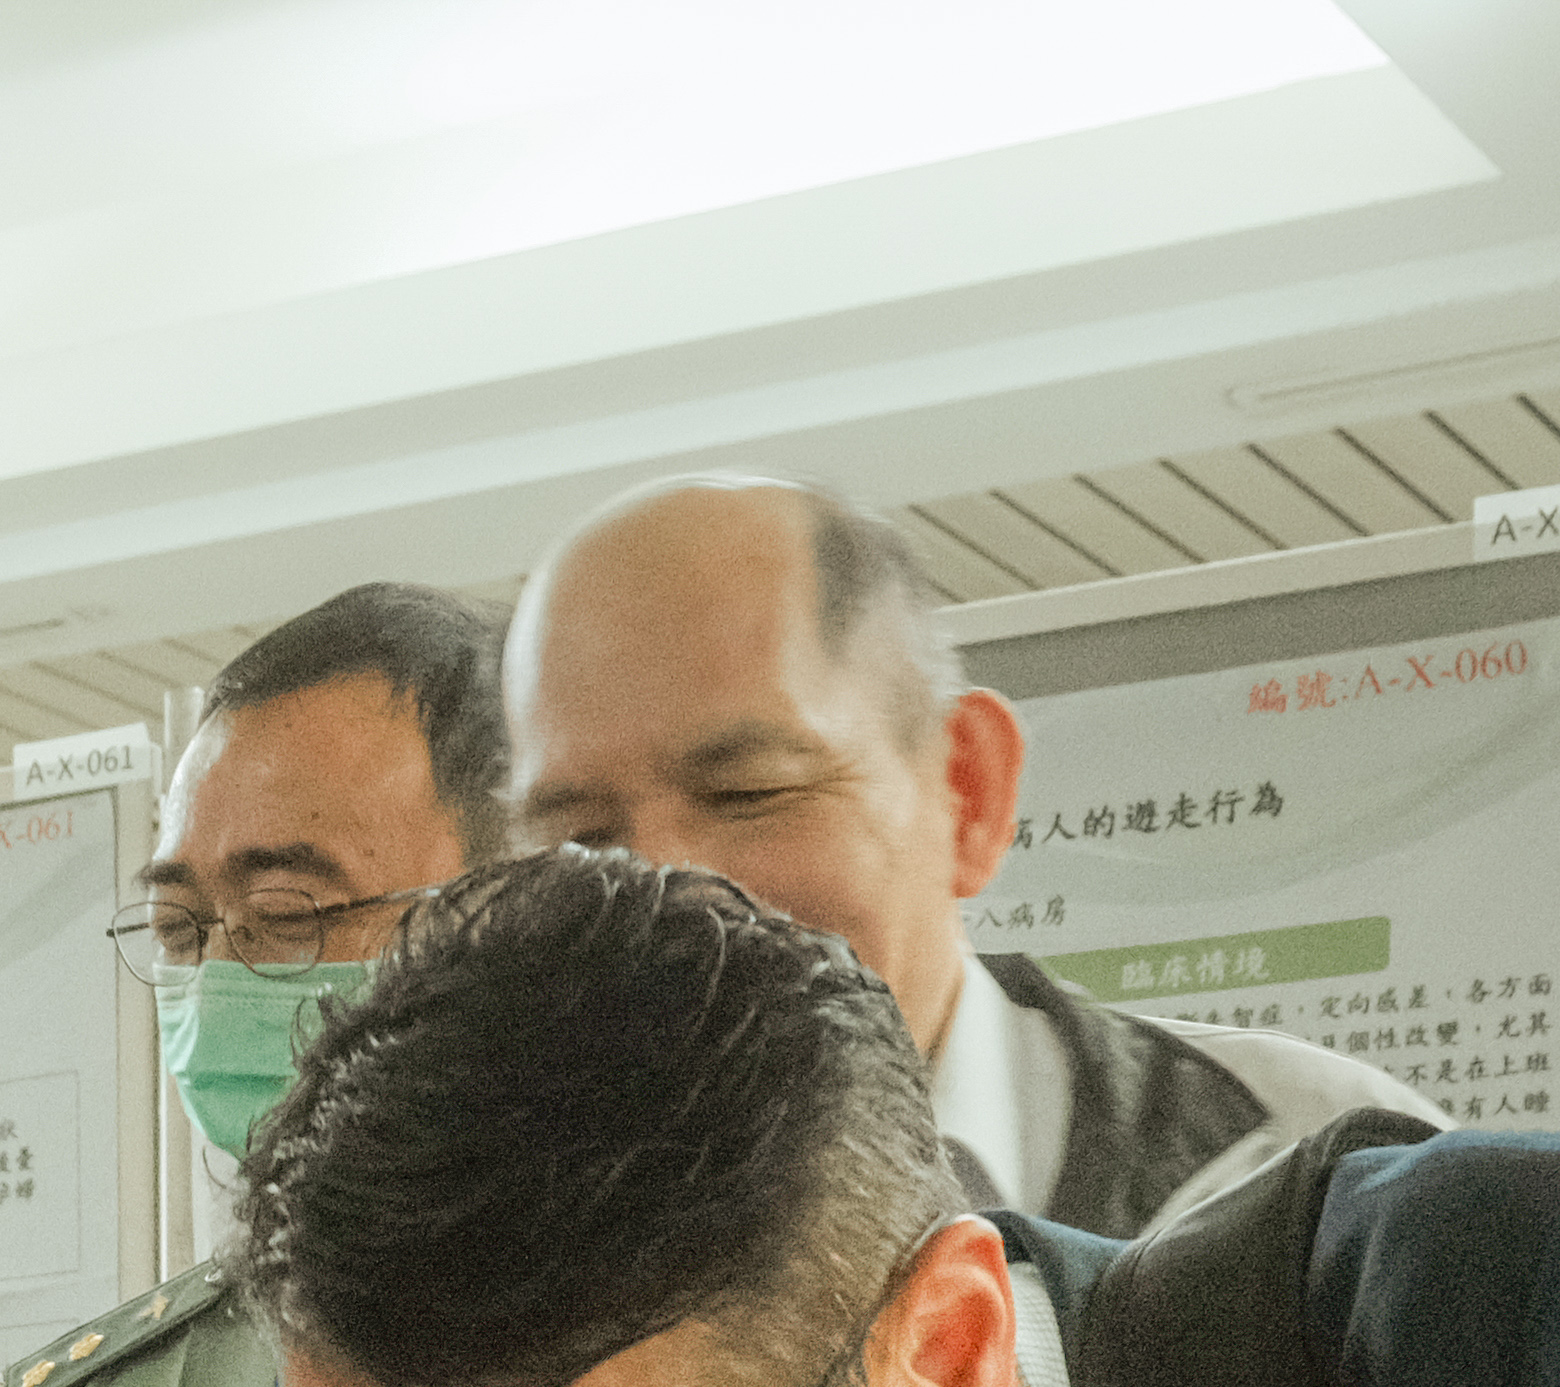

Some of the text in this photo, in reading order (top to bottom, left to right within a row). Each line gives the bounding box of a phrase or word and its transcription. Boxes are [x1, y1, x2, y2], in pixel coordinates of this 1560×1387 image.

[25, 747, 135, 786] A-X-061
[960, 895, 1067, 929] 八病房
[1121, 946, 1269, 991] 臨床情境
[1382, 1052, 1552, 1086] 不是在上班
